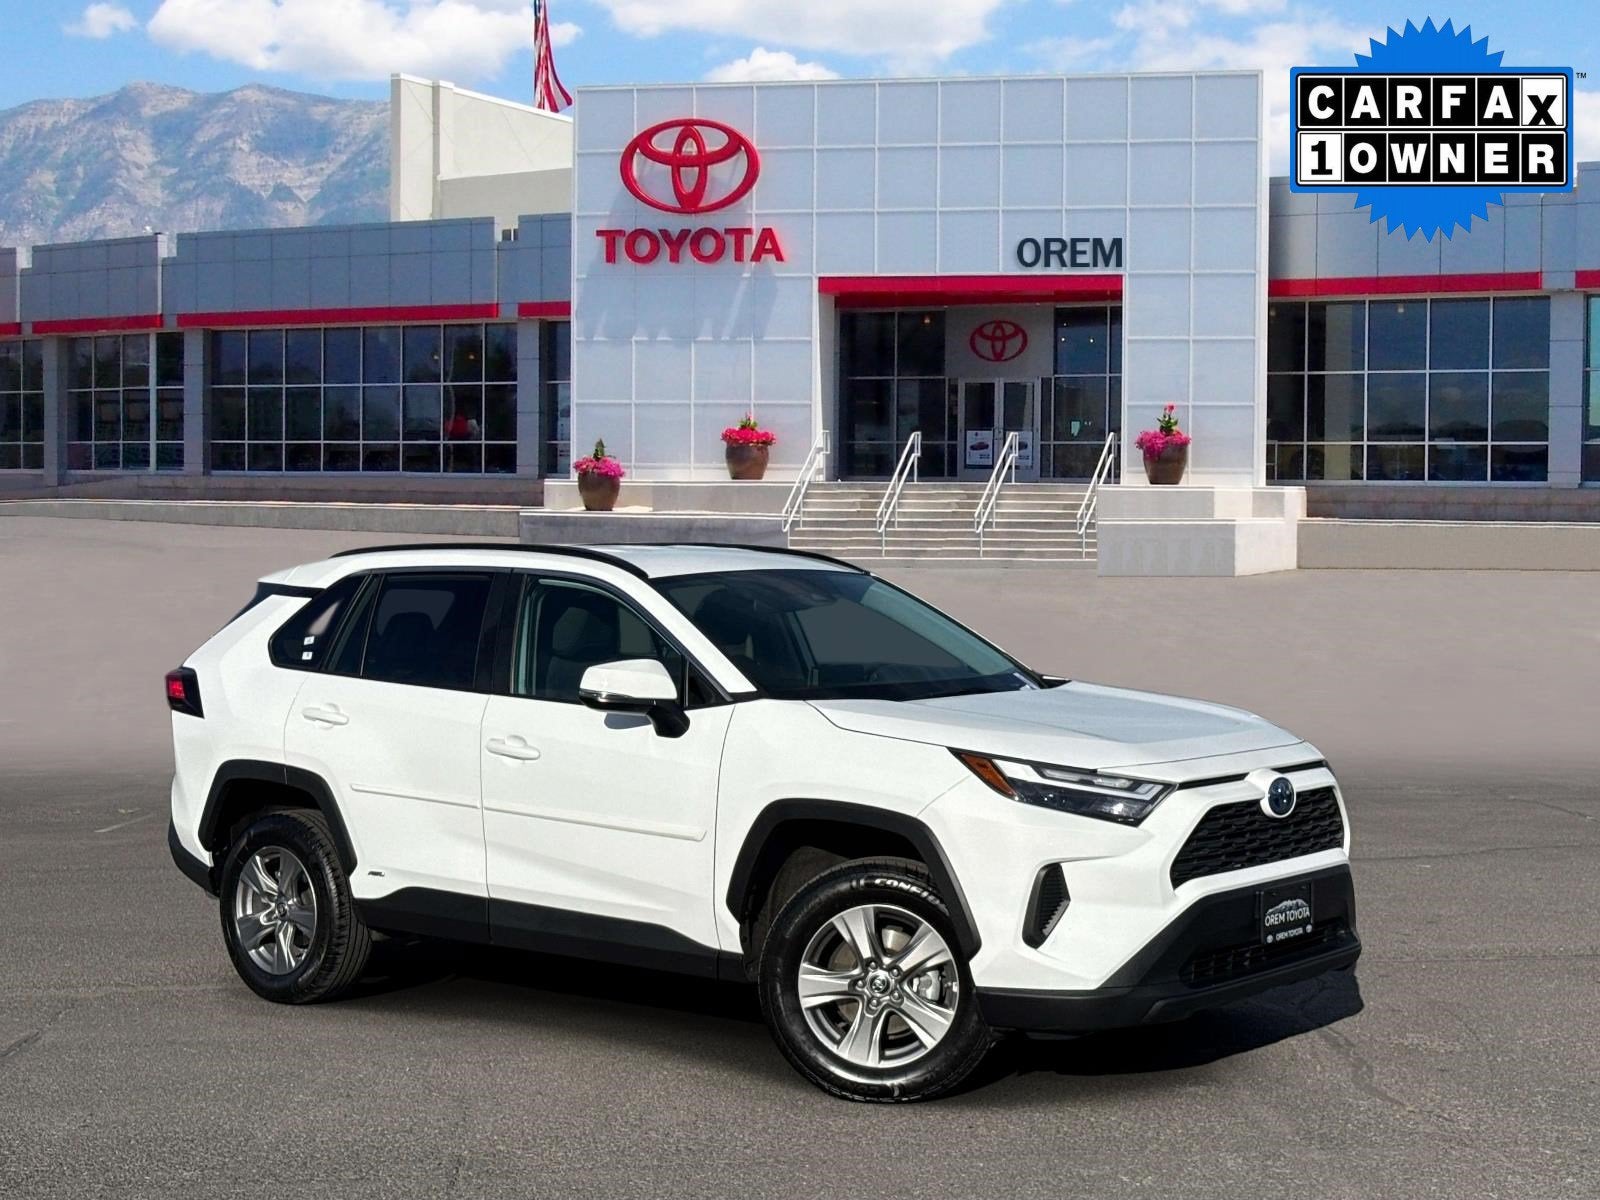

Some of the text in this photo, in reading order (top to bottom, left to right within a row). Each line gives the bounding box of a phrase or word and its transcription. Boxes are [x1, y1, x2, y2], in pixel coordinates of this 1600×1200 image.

[596, 227, 785, 264] TOYOTA
[1017, 237, 1123, 268] OREM
[1265, 907, 1310, 927] OREM TOYOTA
